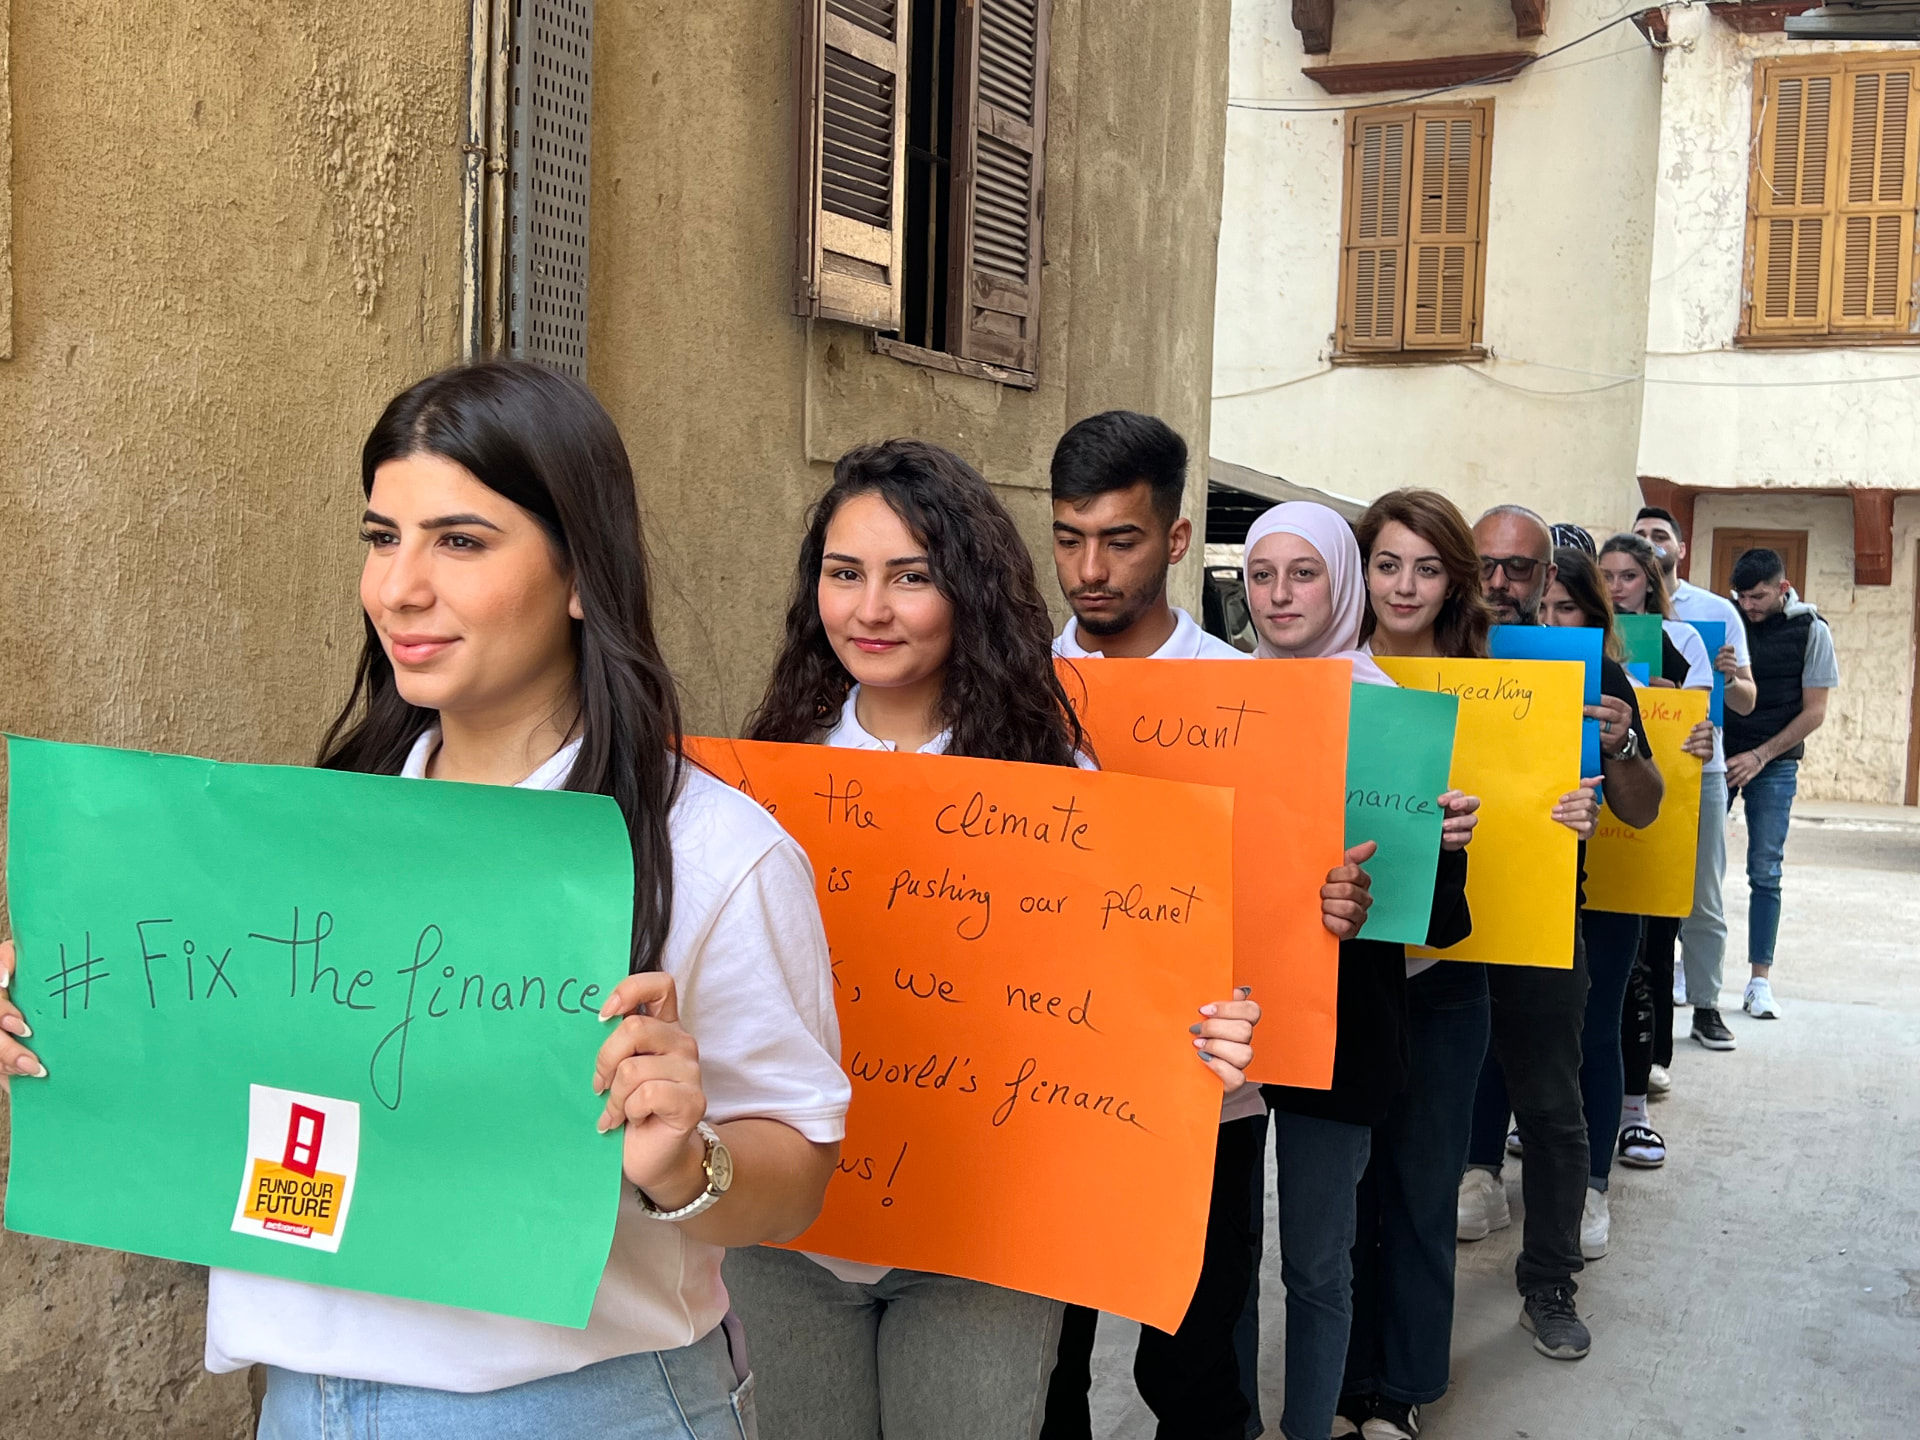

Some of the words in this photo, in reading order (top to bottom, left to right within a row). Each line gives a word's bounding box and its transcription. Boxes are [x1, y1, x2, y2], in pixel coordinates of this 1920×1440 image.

[1132, 700, 1268, 748] want
[814, 773, 882, 830] the
[1346, 788, 1435, 815] nance
[828, 866, 854, 893] is
[887, 868, 993, 940] pushing
[1020, 895, 1069, 914] our
[1101, 884, 1204, 930] planet
[137, 918, 237, 1008] Fix
[370, 923, 602, 1110] finance
[894, 967, 966, 1004] we
[1006, 984, 1104, 1034] need
[851, 1050, 978, 1094] world's
[1624, 1129, 1662, 1144] FILA
[256, 1194, 331, 1218] FUTURE
[259, 1177, 298, 1195] FUND
[301, 1181, 334, 1198] OUR
